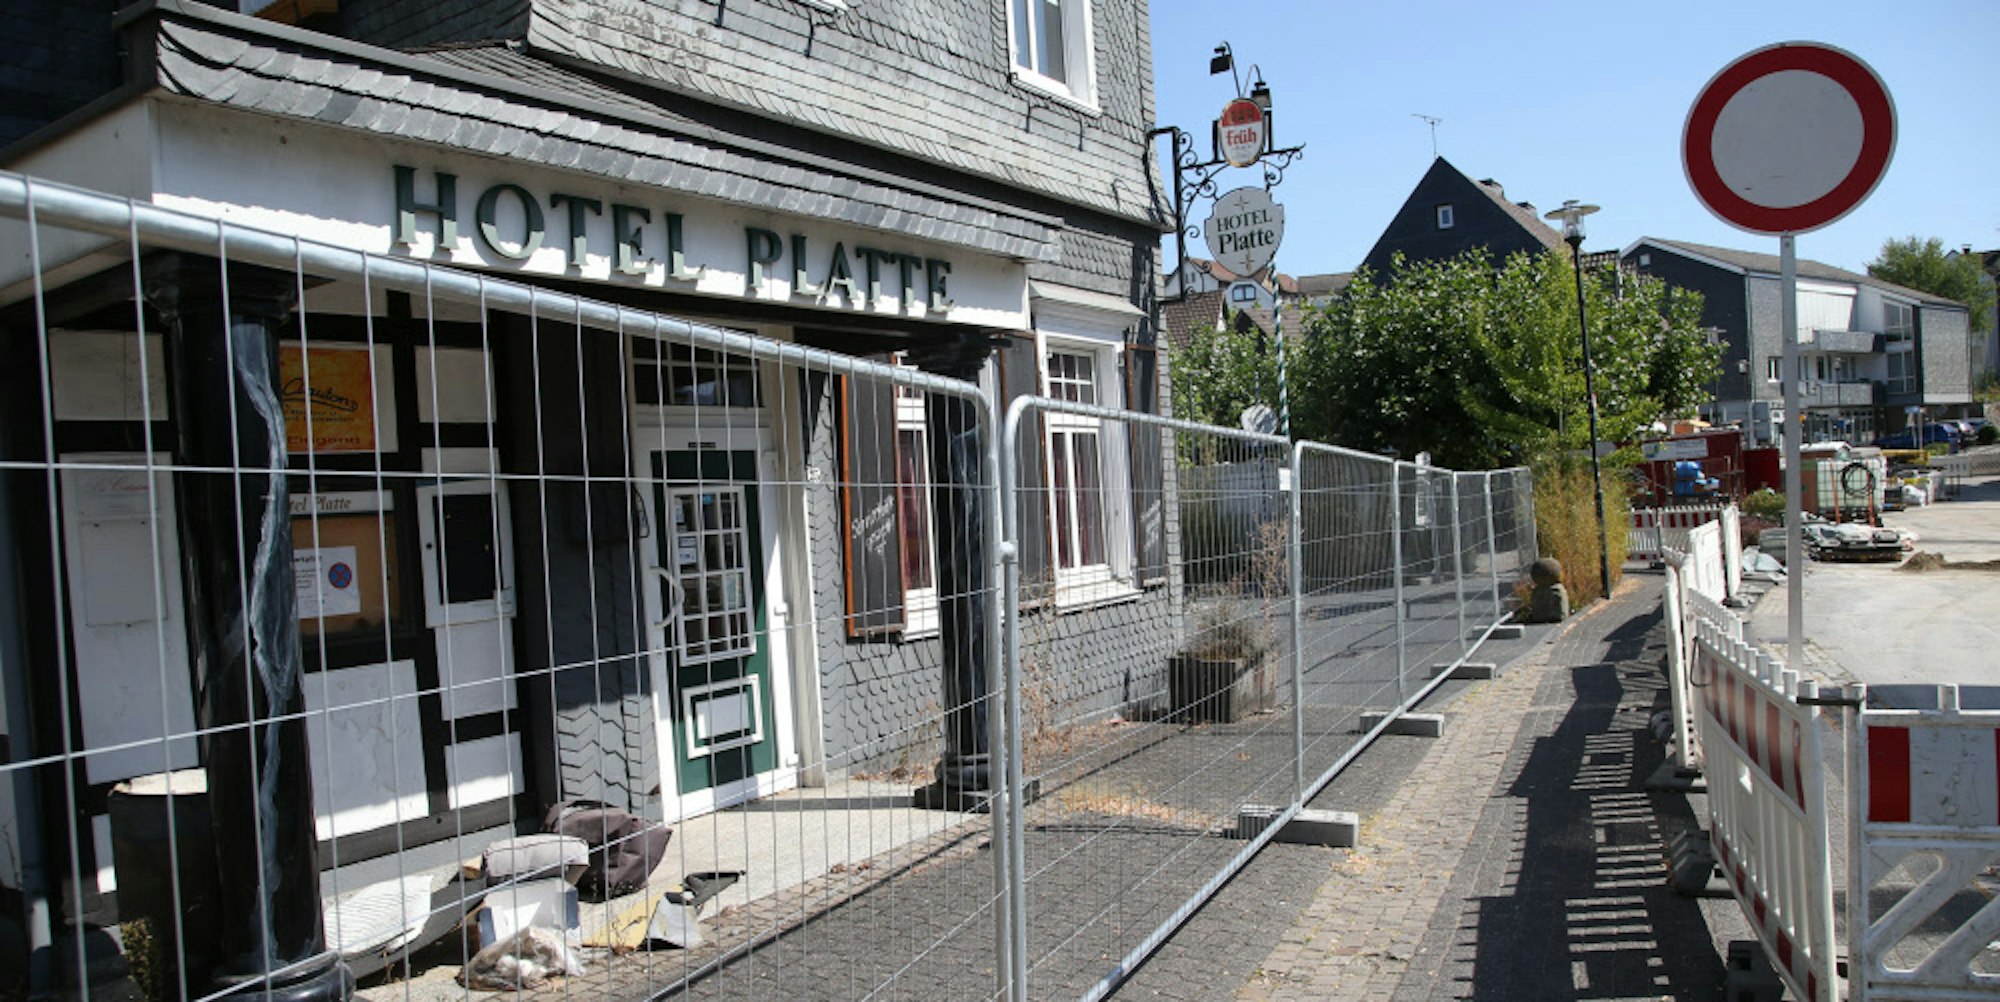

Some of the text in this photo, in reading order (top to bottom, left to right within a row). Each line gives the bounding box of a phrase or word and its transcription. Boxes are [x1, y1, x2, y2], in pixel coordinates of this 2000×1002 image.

[1217, 208, 1273, 233] HOTEL
[393, 165, 955, 314] HOTEL PLATTE
[1218, 229, 1274, 254] Platte
